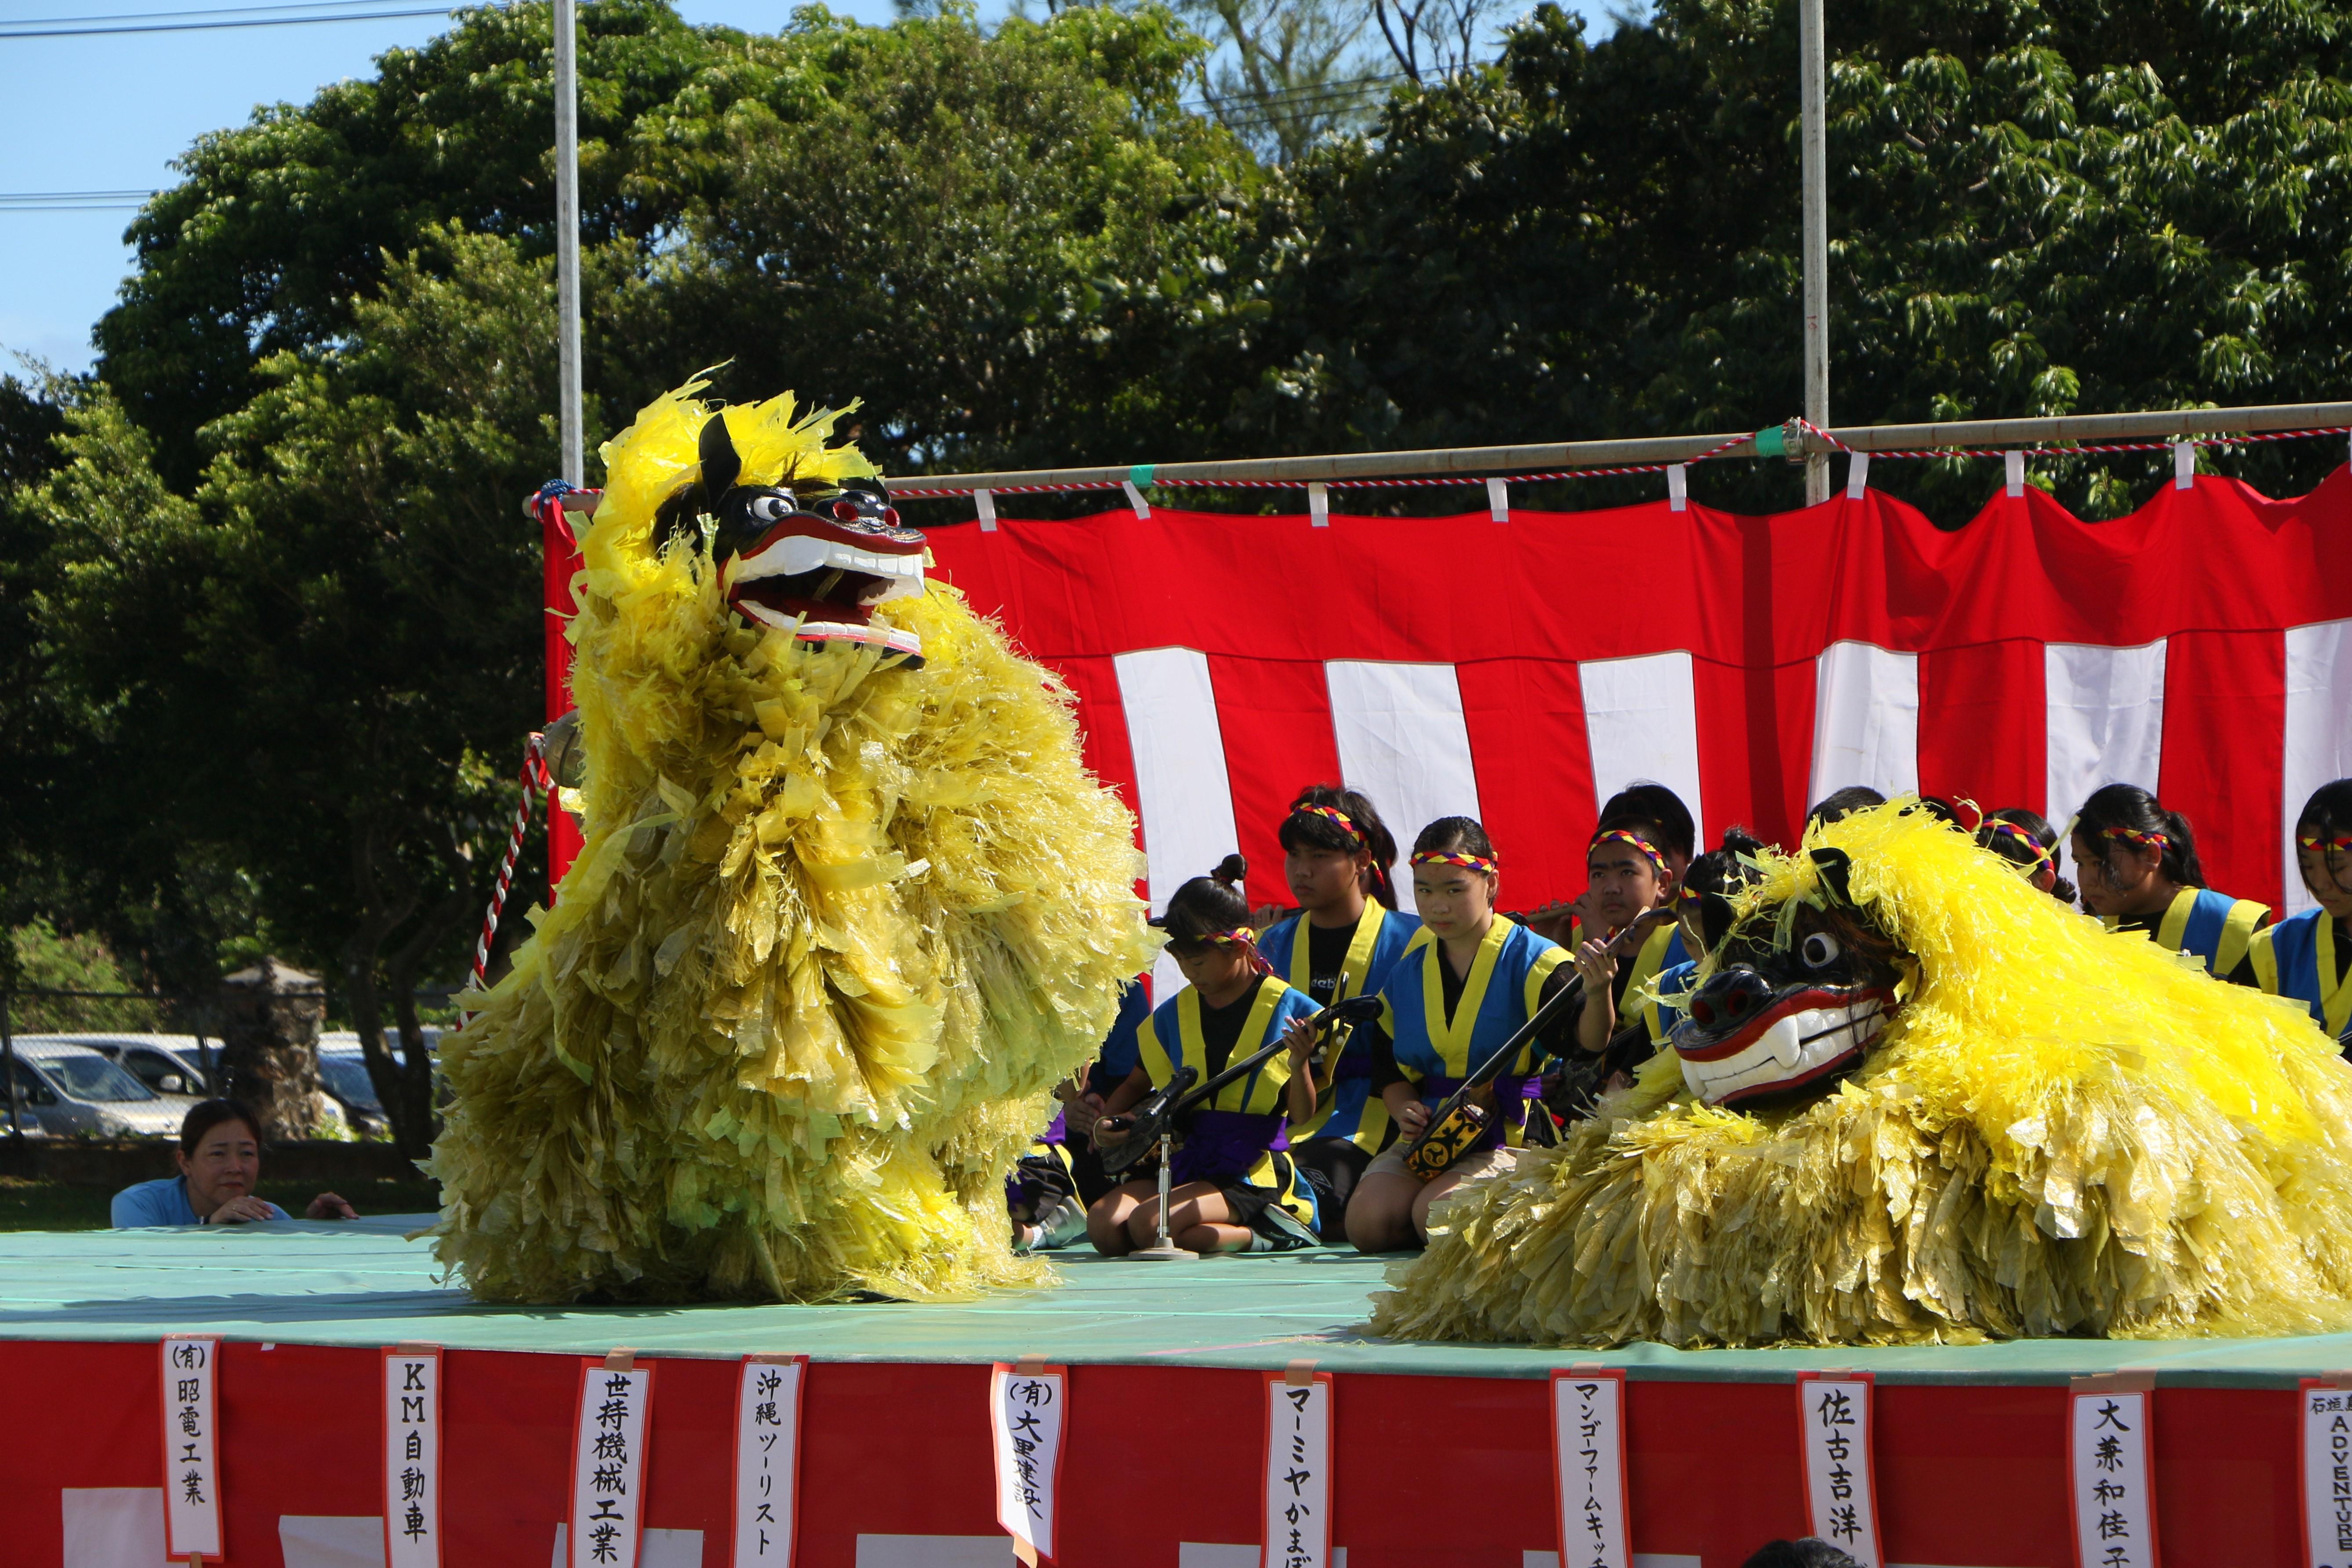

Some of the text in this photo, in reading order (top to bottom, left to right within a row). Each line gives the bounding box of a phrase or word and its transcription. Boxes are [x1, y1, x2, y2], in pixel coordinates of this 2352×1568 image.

[172, 1344, 205, 1506] (有)昭電工業
[400, 1363, 428, 1544] KM自動車
[588, 1372, 632, 1565] 世持機械工業
[755, 1368, 782, 1556] 沖縄ツーリスト
[1817, 1388, 1863, 1546] 佐古吉洋
[2330, 1416, 2352, 1552] ADVENTURE
